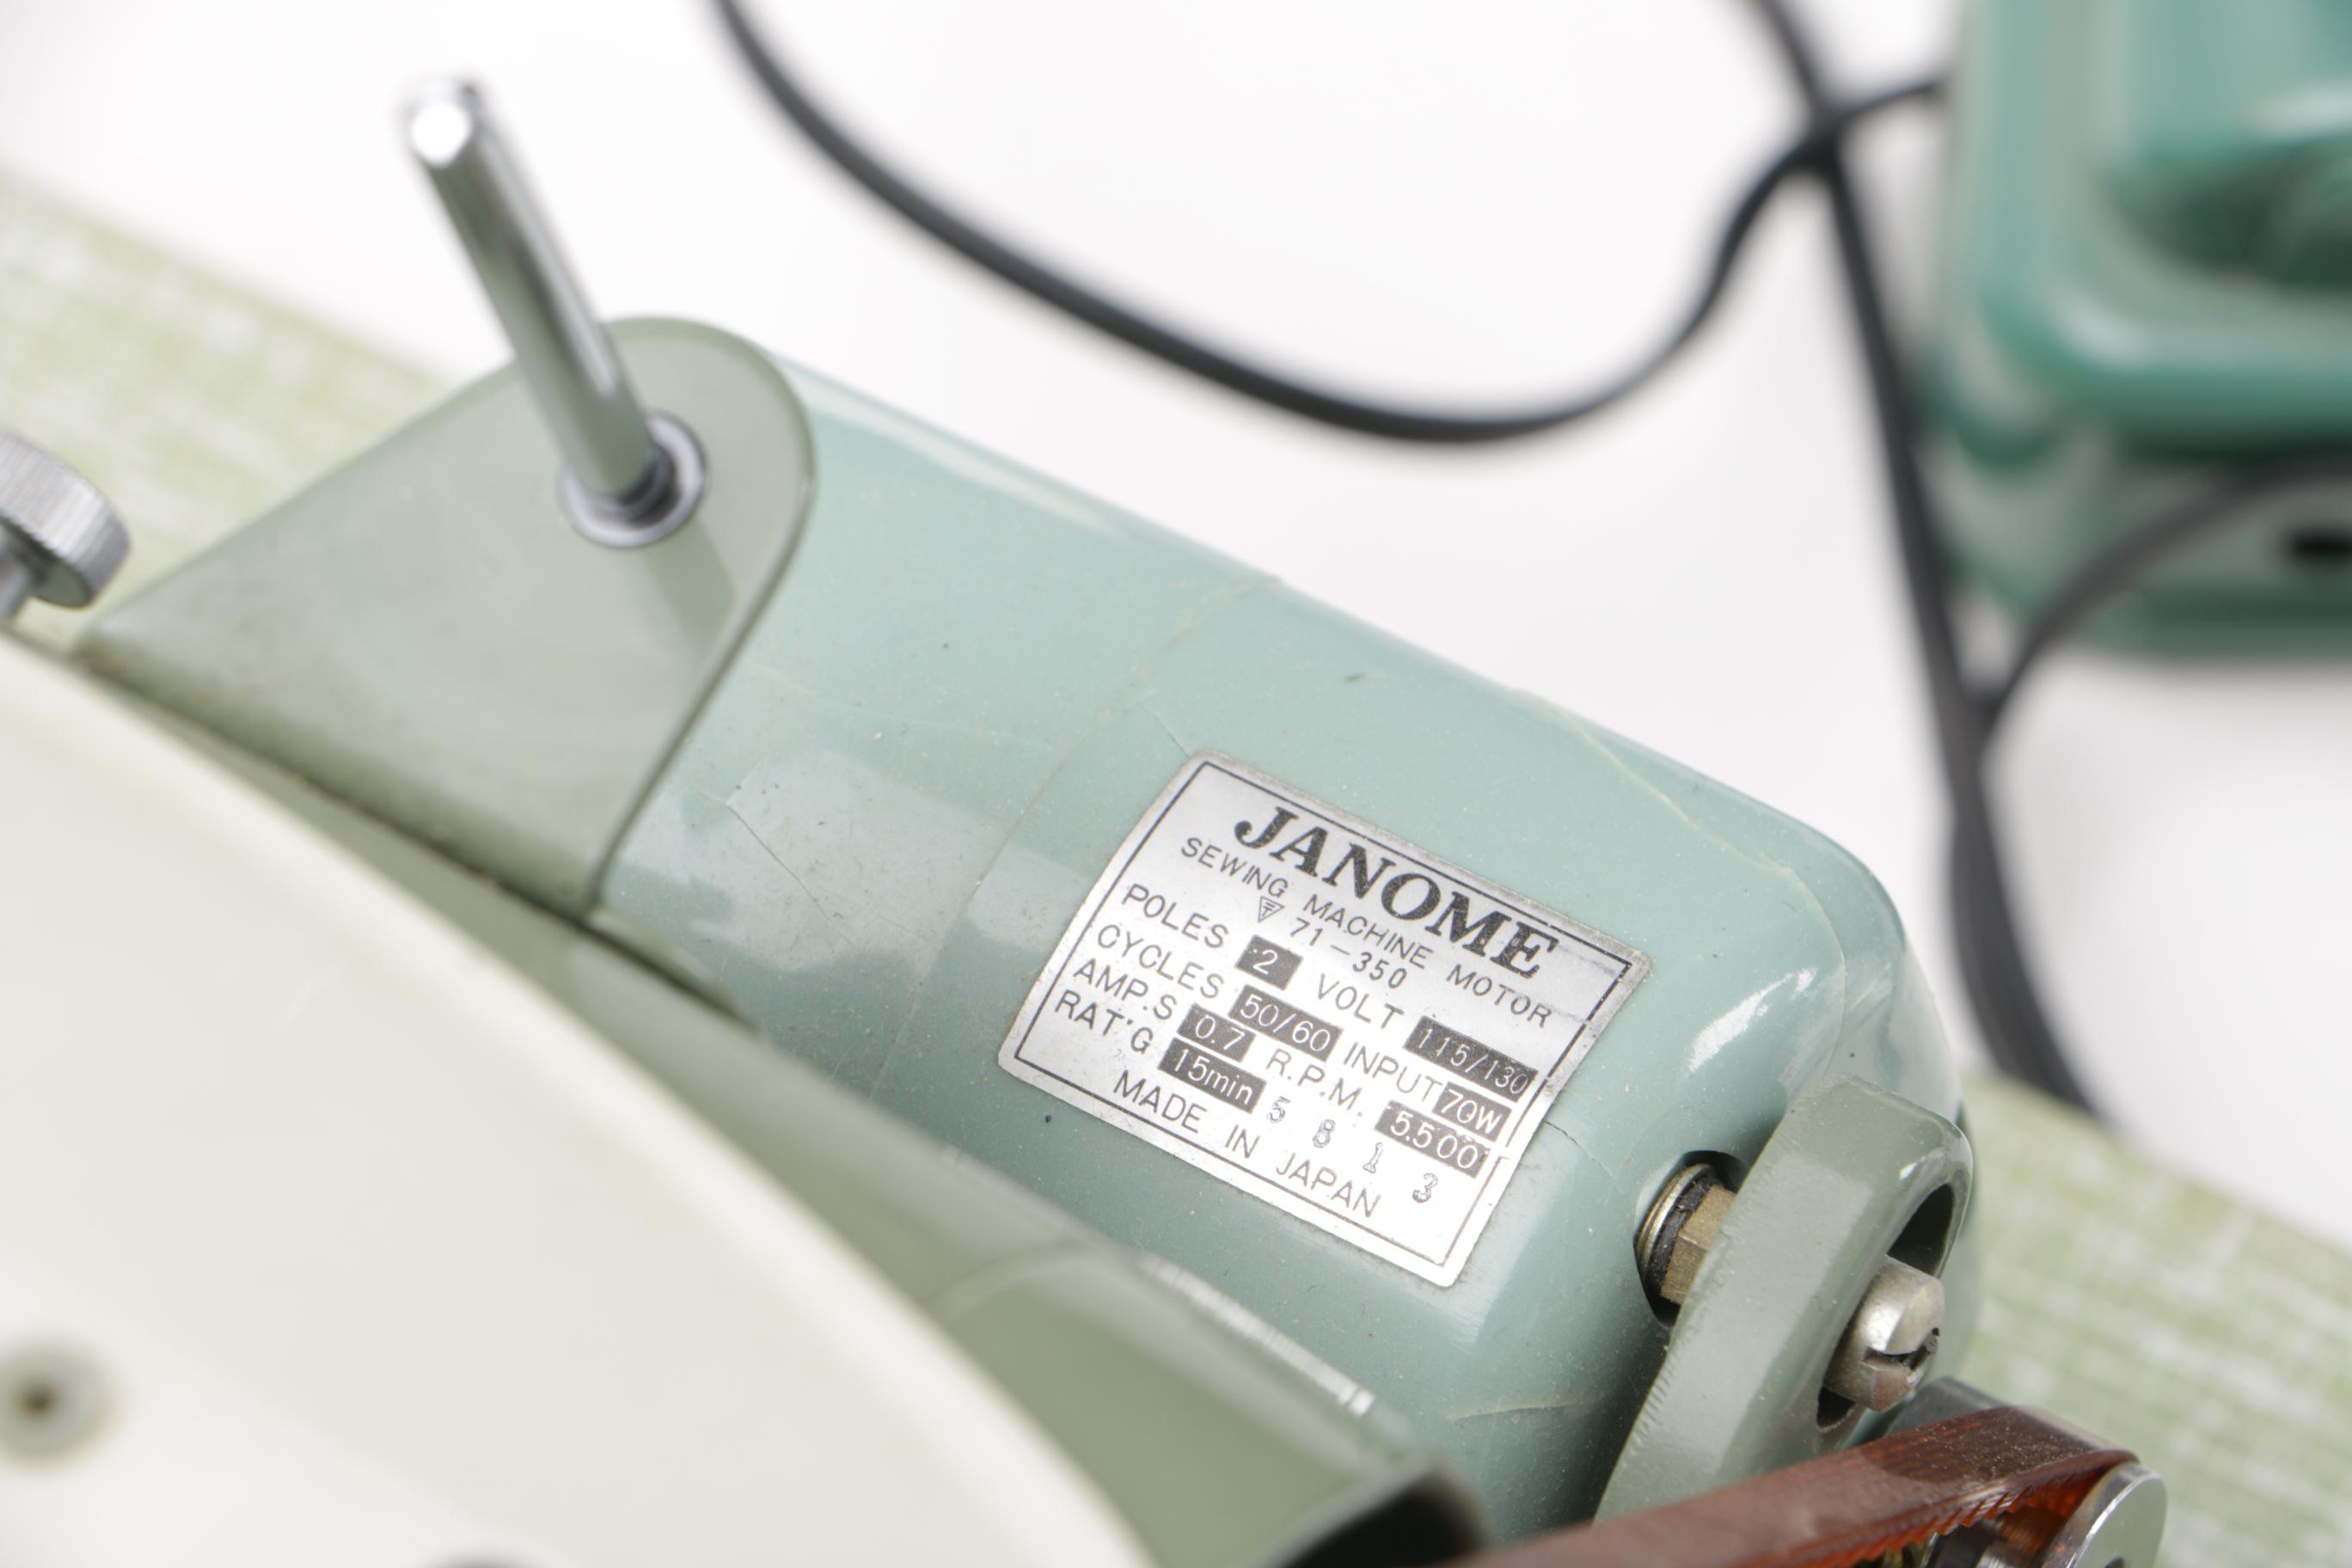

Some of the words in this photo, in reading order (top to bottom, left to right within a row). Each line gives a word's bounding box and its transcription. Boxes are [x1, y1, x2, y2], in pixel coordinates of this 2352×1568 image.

[1181, 837, 1289, 897] SEWING
[1302, 894, 1434, 969] MACHINE
[1446, 964, 1552, 1027] MOTOR
[1234, 806, 1559, 978] JANOME
[1097, 924, 1224, 999] CYCLES
[1240, 994, 1331, 1051] 50/60
[1343, 1041, 1442, 1101] INPUT
[1442, 1089, 1503, 1134] 70W
[1121, 883, 1229, 948] POLES
[1253, 949, 1278, 975] 2
[1318, 973, 1404, 1029] VOLT
[1418, 1029, 1528, 1094] 115/130
[1113, 1069, 1207, 1133] MADE
[1225, 1124, 1259, 1159] IN
[1276, 1153, 1381, 1217] JAPAN
[1174, 1048, 1253, 1106] 15min
[1195, 1015, 1245, 1050] 0.7
[1266, 1048, 1363, 1117] R.P.M.
[1390, 1111, 1479, 1169] 5.500
